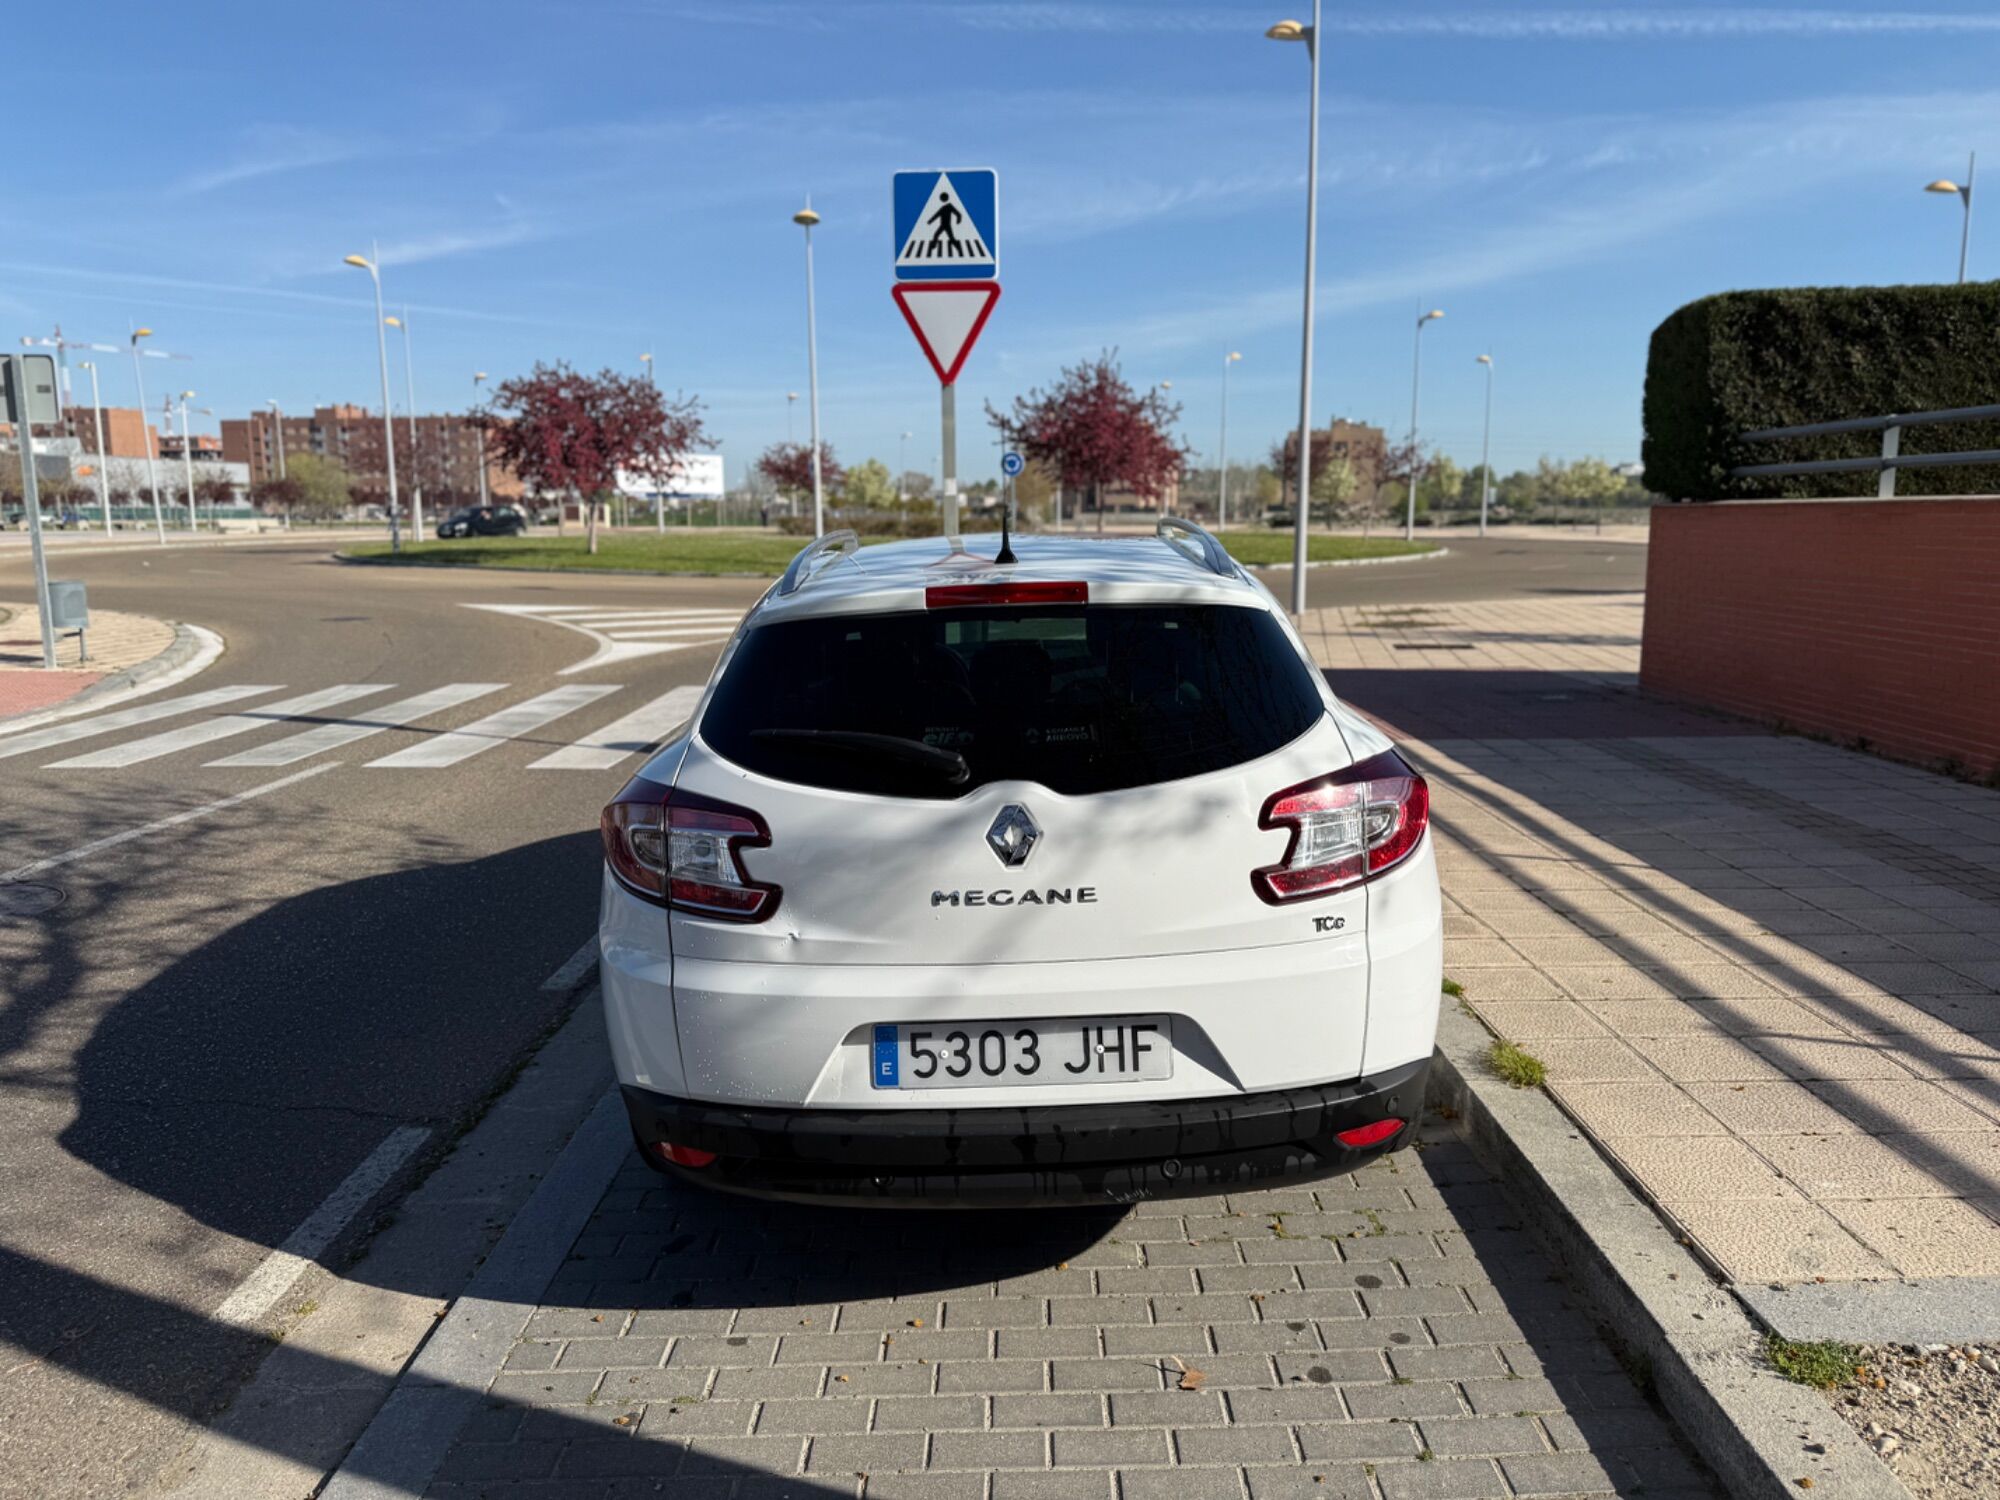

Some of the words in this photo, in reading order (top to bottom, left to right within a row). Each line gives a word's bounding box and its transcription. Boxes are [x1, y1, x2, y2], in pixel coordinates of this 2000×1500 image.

[931, 887, 1098, 907] MEGANE
[881, 1063, 893, 1075] E
[910, 1028, 1041, 1078] 5303
[1064, 1025, 1158, 1074] JHF
